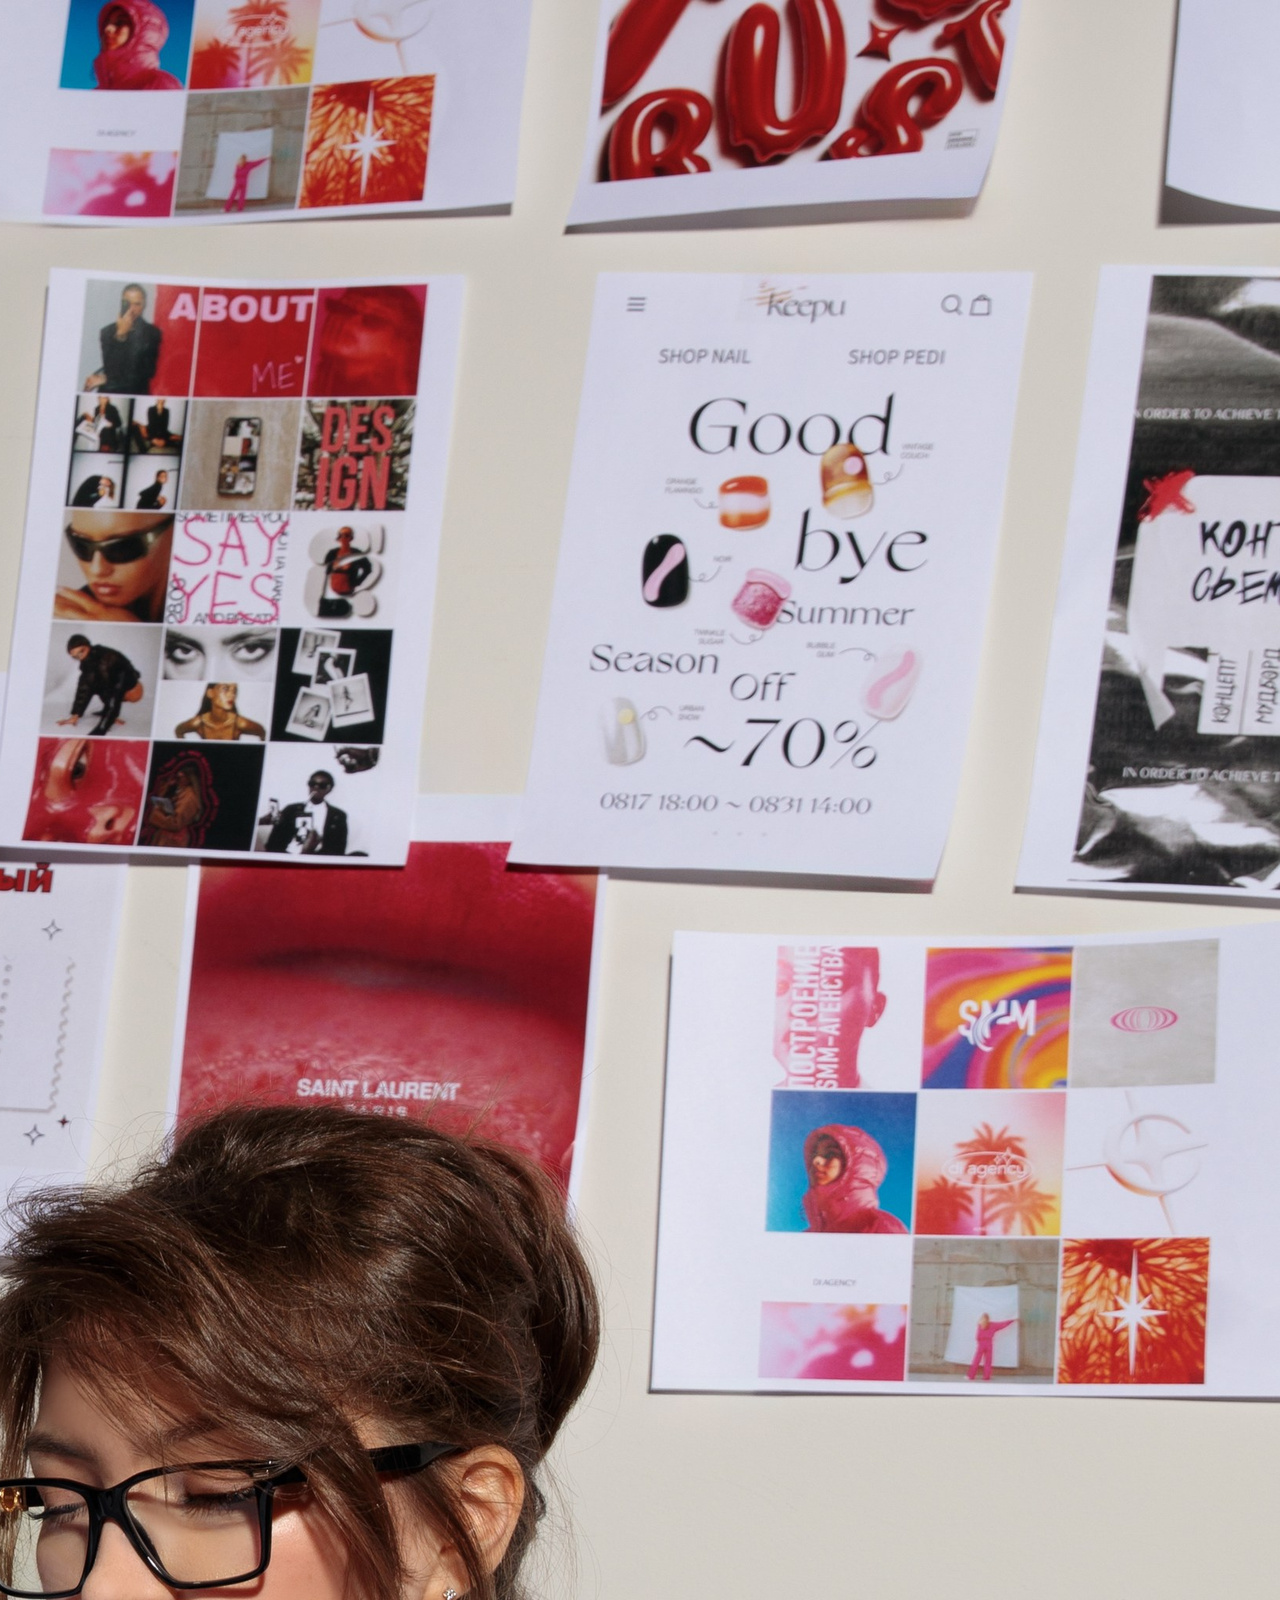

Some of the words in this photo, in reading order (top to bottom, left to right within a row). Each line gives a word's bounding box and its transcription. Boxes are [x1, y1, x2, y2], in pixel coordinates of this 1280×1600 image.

[168, 292, 317, 323] ABOUT
[658, 348, 706, 364] SHOP
[711, 349, 751, 364] NAIL
[847, 349, 898, 365] SHOP
[903, 350, 946, 365] PEDI
[252, 361, 295, 393] ME
[321, 405, 395, 453] DES
[688, 392, 896, 457] Good
[1143, 407, 1191, 419] ORDER
[1193, 408, 1213, 420] TO
[1214, 408, 1274, 420] ACHIEVE
[314, 455, 391, 510] IGN
[173, 514, 290, 567] SAY
[794, 508, 929, 585] bye
[172, 570, 279, 625] YES
[777, 600, 915, 626] Summer
[589, 644, 719, 674] Season
[730, 672, 797, 701] Off
[1212, 656, 1237, 724] КОНЦЕПТ
[683, 717, 882, 769] ~70%
[1139, 767, 1185, 780] ORDER
[1187, 767, 1208, 781] TO
[1208, 770, 1269, 783] ACHIEVE
[600, 792, 652, 811] 0817
[658, 794, 719, 812] 18:00
[749, 796, 805, 814] 0831
[810, 797, 872, 815] 14:00
[297, 1078, 359, 1098] SAINT
[362, 1081, 461, 1101] LAURENT
